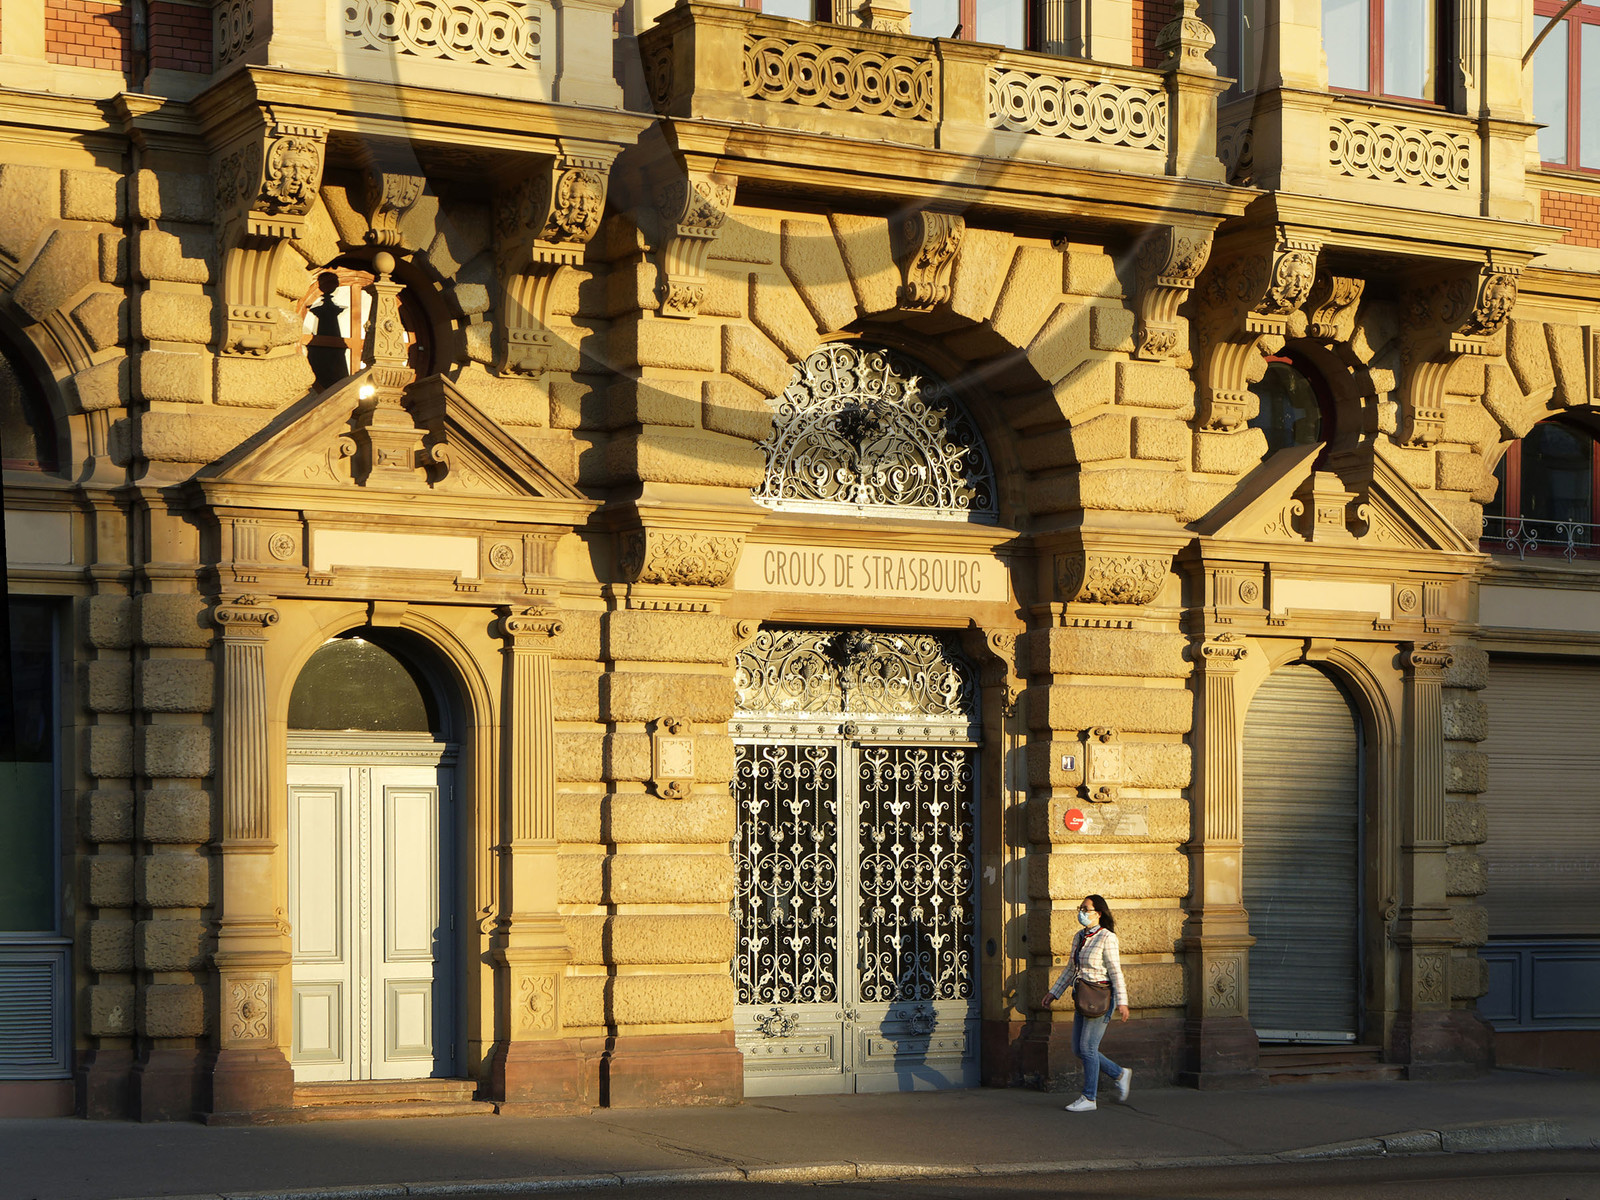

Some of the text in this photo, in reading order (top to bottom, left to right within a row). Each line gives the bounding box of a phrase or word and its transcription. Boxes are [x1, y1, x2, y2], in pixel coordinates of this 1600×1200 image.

[764, 550, 981, 594] CROUS DE STRASBOURG
